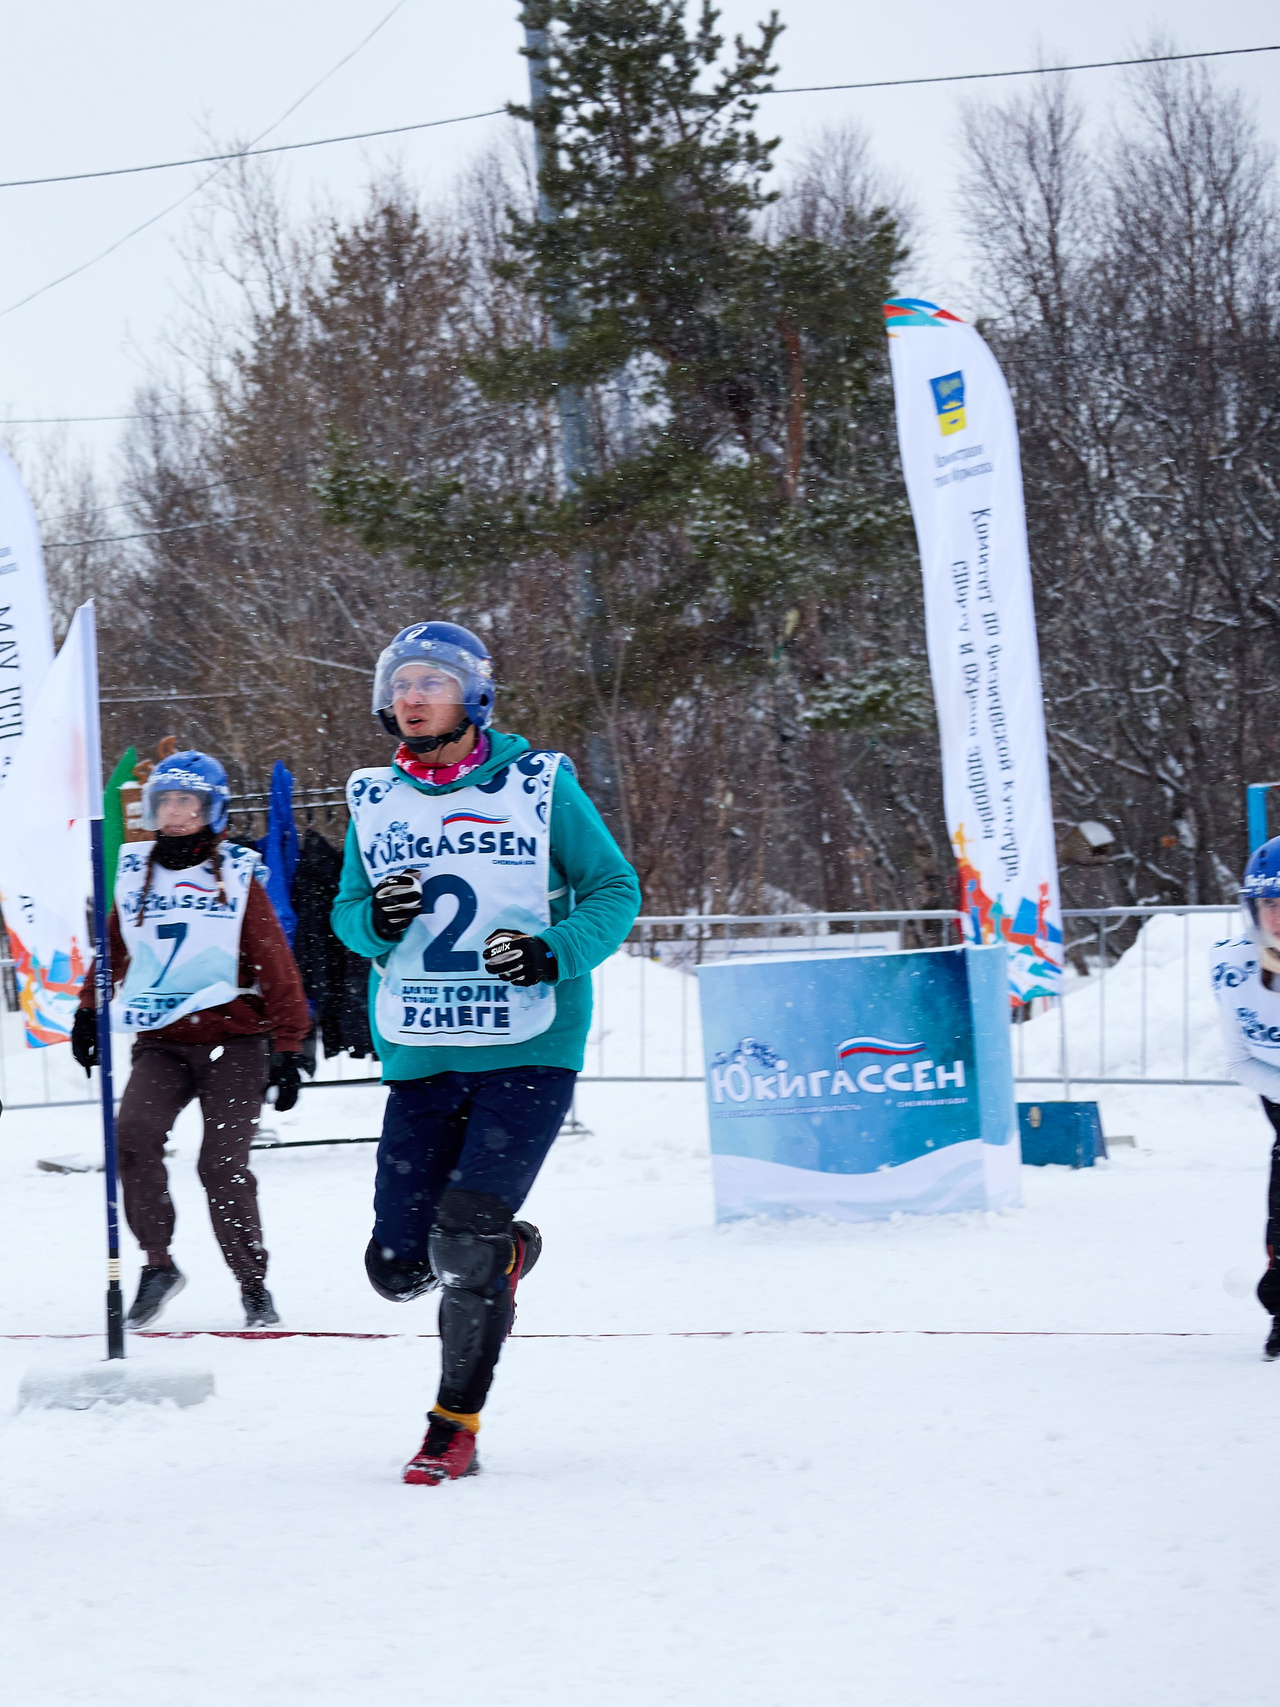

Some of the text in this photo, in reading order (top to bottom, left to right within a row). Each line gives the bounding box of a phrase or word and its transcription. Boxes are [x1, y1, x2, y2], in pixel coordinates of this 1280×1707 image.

[982, 612, 1000, 636] по
[959, 642, 975, 656] и
[419, 874, 479, 972] 2
[150, 922, 189, 988] 7
[443, 986, 510, 1003] ТОЛК
[402, 1006, 511, 1028] В СНЕГЕ
